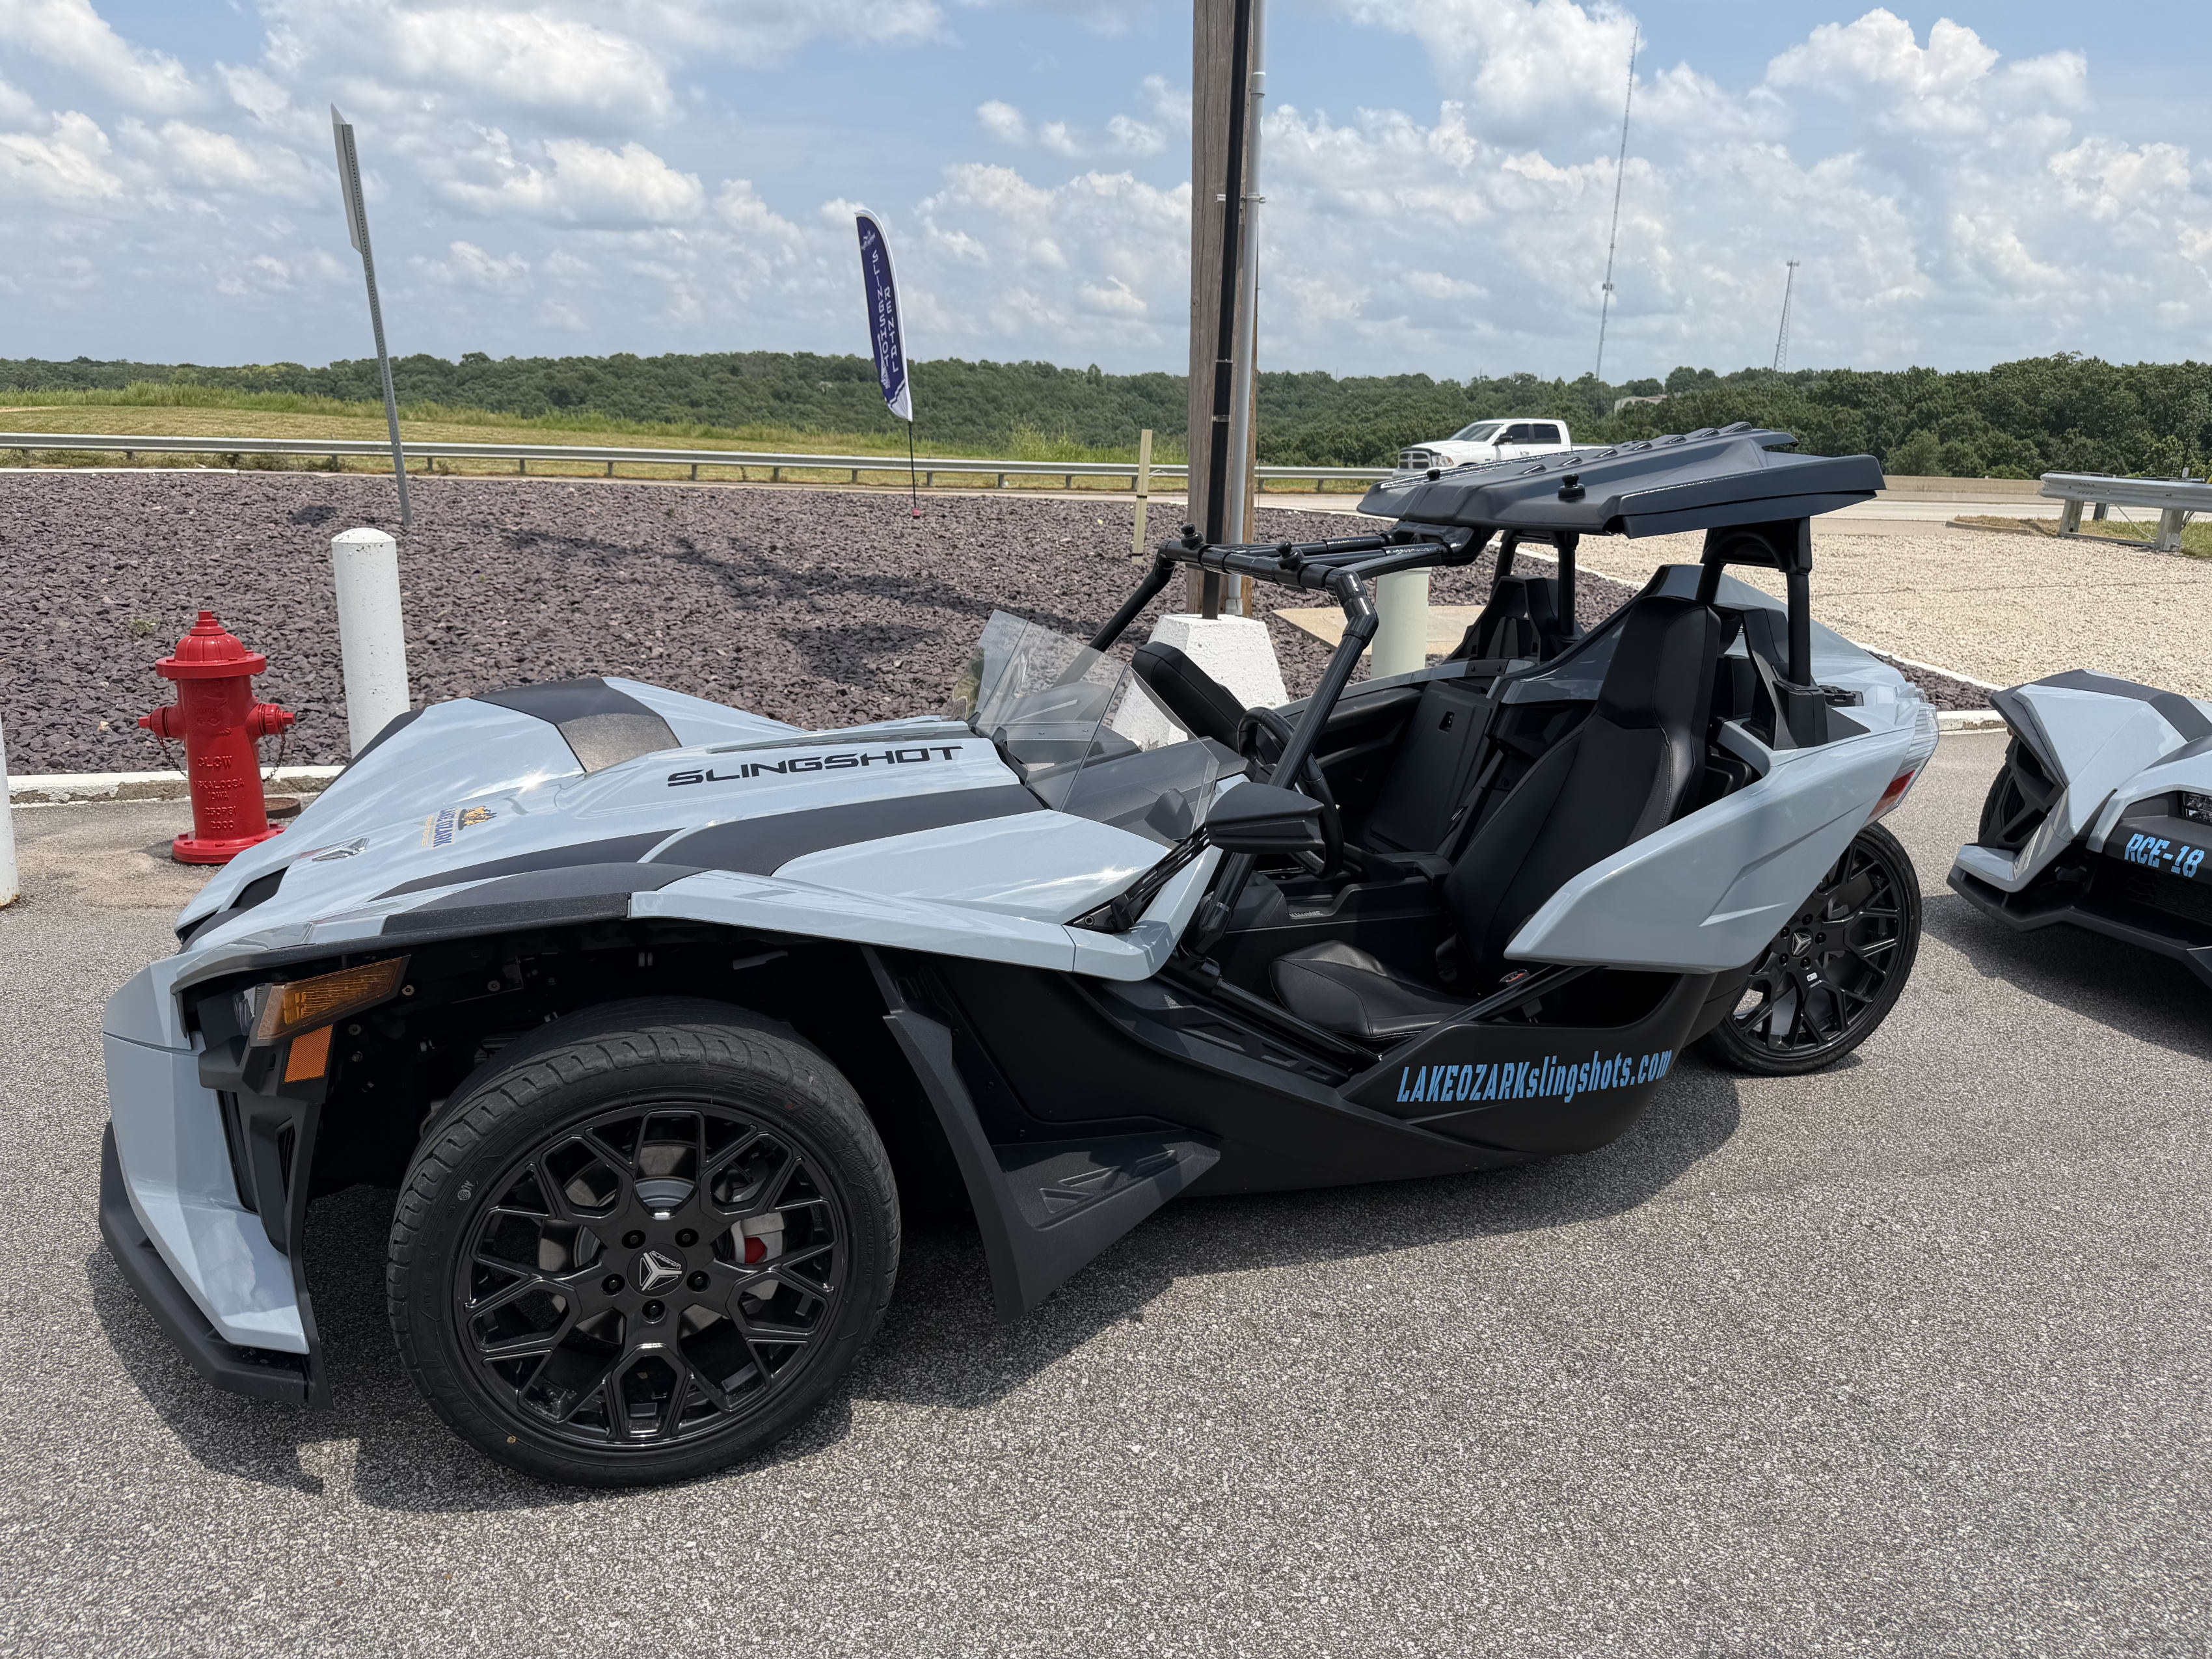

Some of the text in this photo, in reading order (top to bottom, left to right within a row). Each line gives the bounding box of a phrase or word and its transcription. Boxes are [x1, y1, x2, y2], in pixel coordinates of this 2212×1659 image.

[872, 249, 889, 367] SLINGSHOT
[883, 286, 899, 373] RENTAL
[667, 746, 964, 787] SLINGSHOT
[433, 820, 454, 848] OZARK
[2124, 833, 2205, 879] RCE-18
[1396, 1049, 1673, 1103] LAKEOZARKslingshots.com
